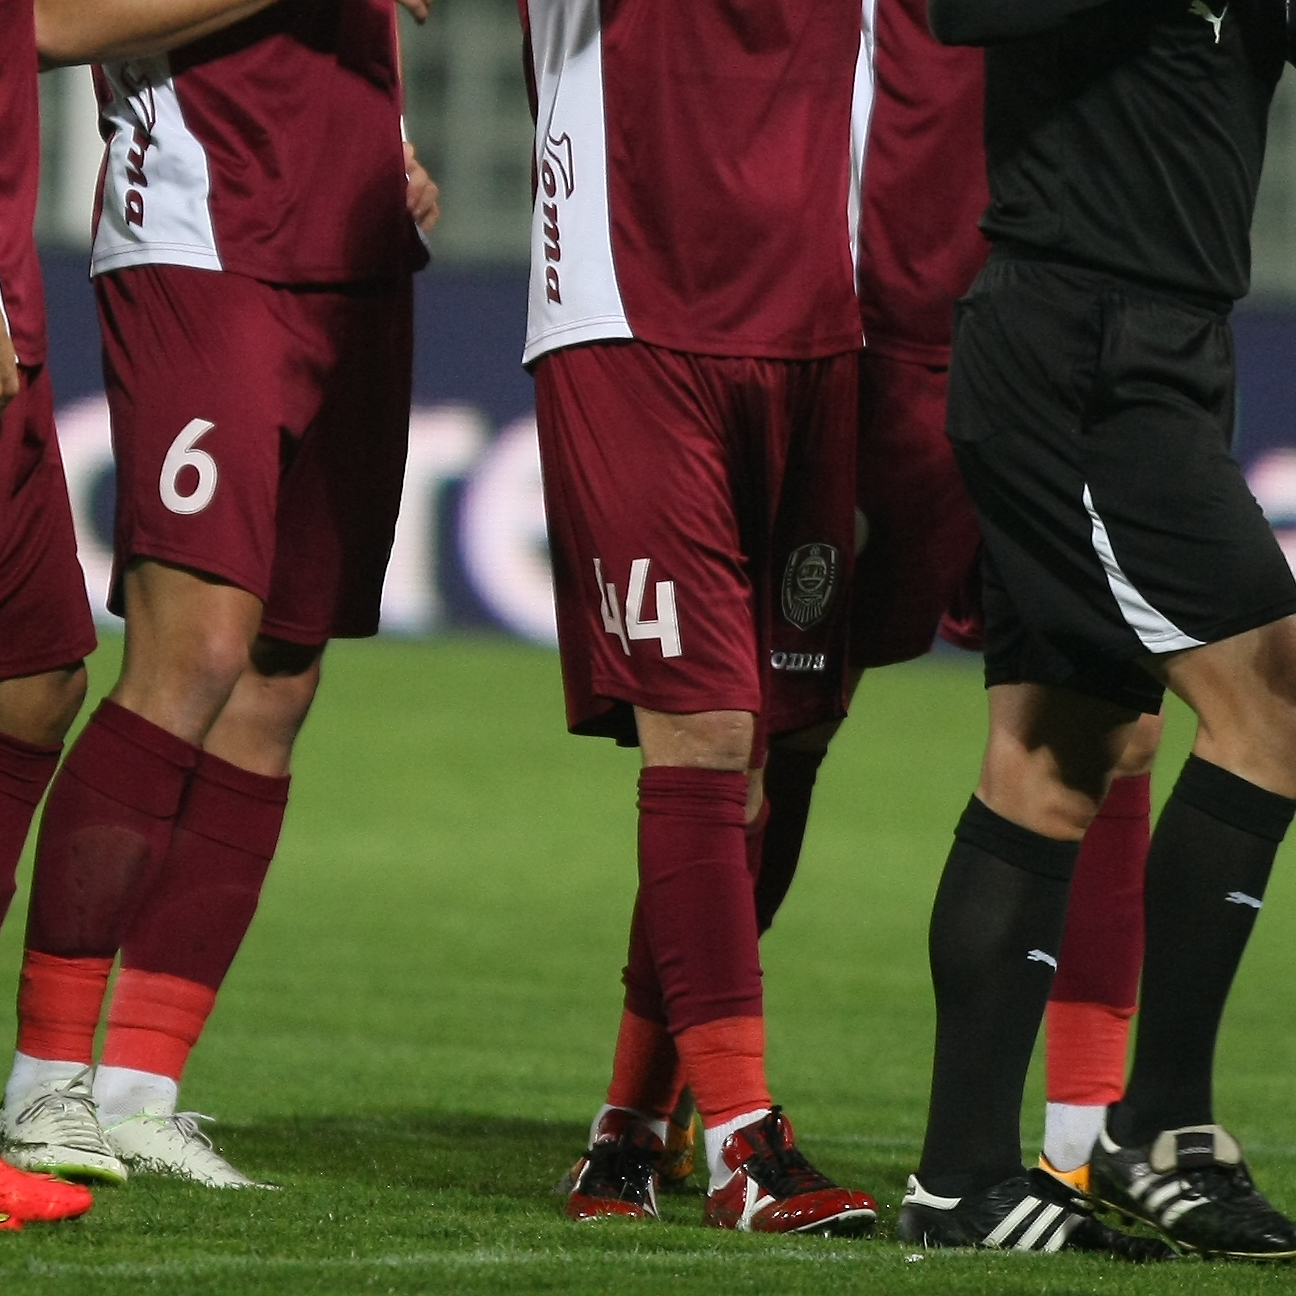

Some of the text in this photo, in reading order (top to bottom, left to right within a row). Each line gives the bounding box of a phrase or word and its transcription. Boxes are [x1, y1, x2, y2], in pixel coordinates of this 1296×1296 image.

[159, 417, 219, 515] 6
[592, 557, 683, 658] 44
[769, 650, 825, 671] oma
